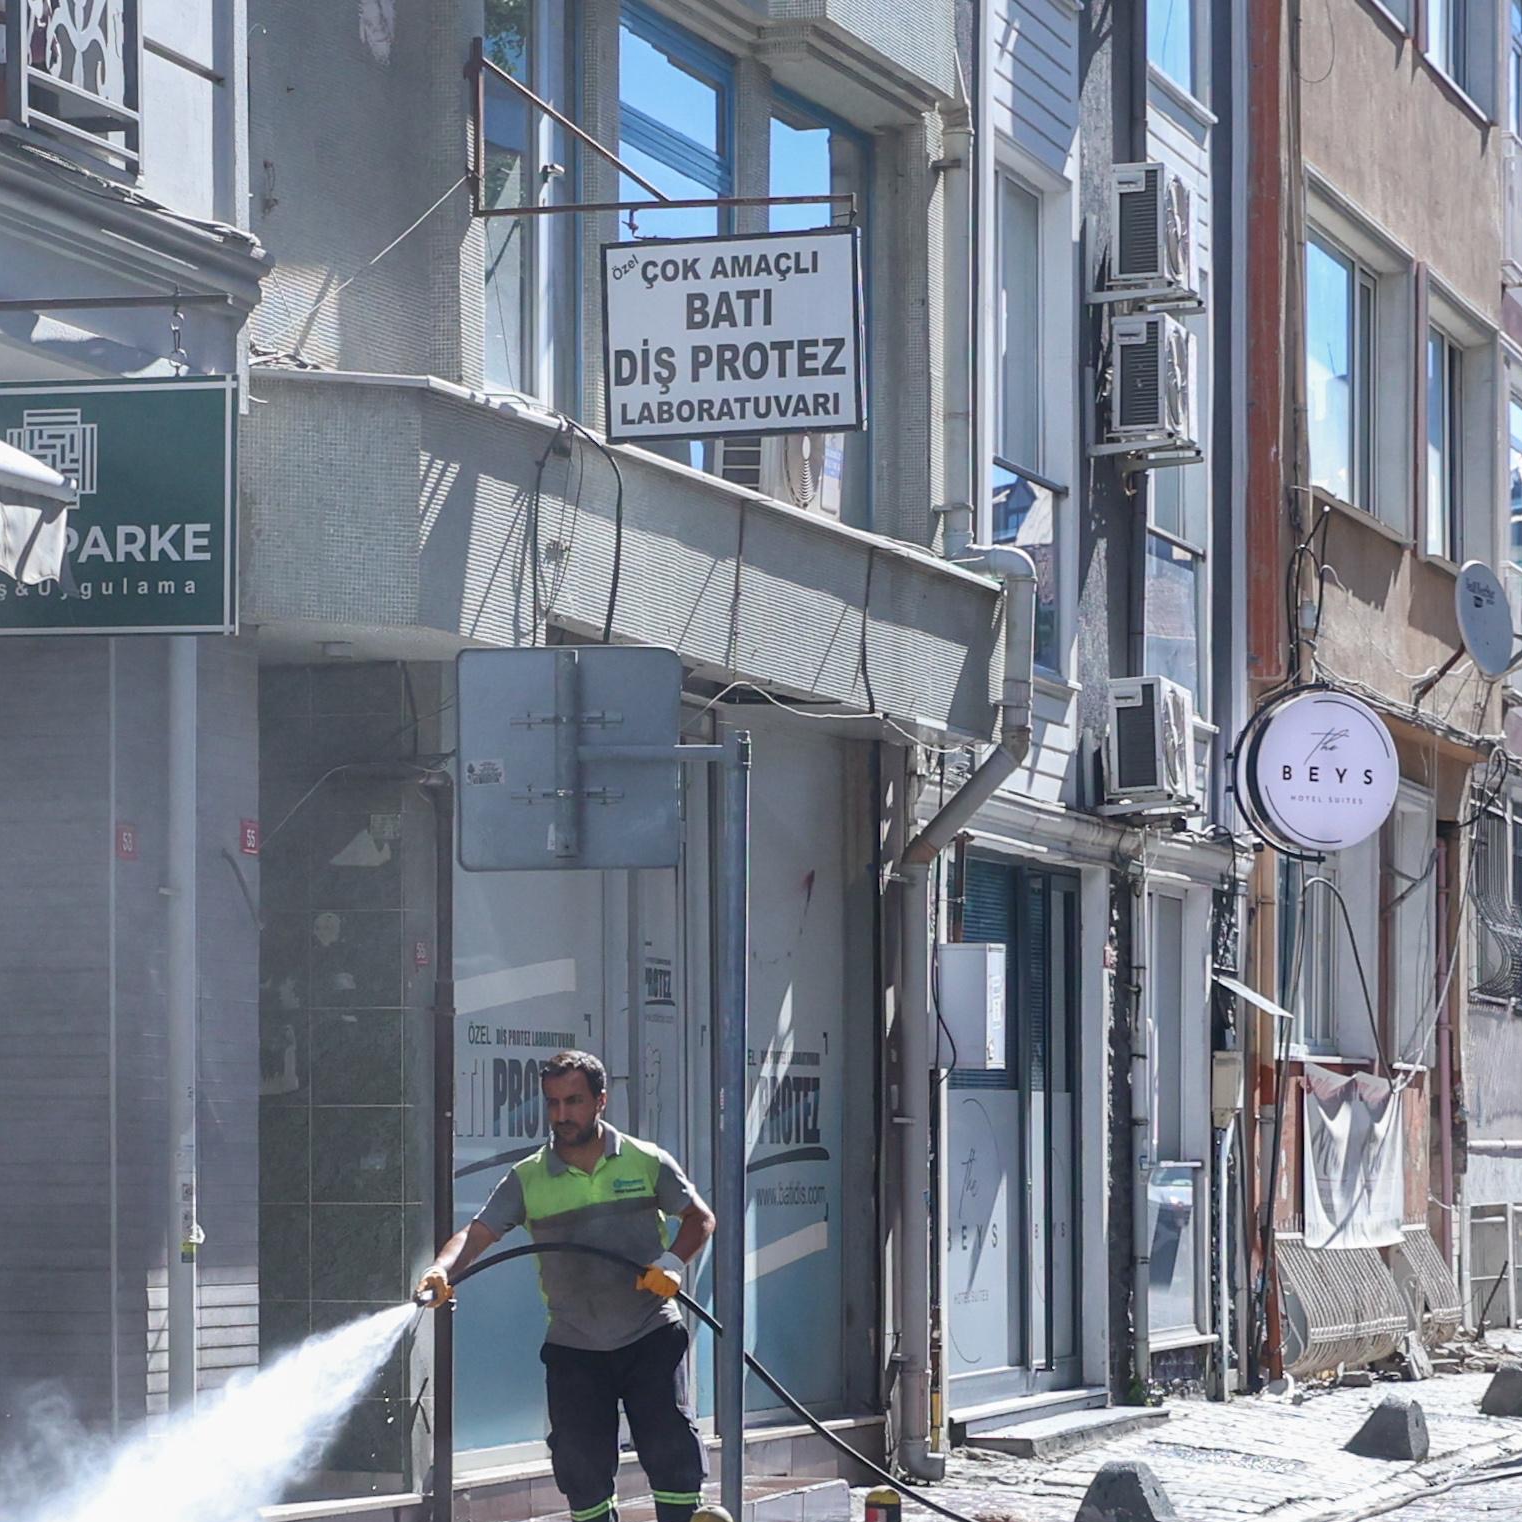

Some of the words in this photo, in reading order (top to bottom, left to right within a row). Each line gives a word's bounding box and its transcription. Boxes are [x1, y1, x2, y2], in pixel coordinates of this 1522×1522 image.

[611, 254, 640, 281] Özel
[640, 257, 701, 289] ÇOK
[710, 250, 819, 282] AMAÇLI
[685, 288, 773, 330] BATI
[613, 338, 677, 395] DİŞ
[690, 337, 847, 384] PROTEZ
[620, 392, 841, 426] LABORATUVARI
[66, 522, 213, 564] PARKE
[1282, 764, 1373, 785] BEYS
[1290, 794, 1322, 804] HOTEL
[1328, 795, 1364, 806] SUITES
[246, 829, 256, 848] 55
[468, 1021, 492, 1045] ÖZEL
